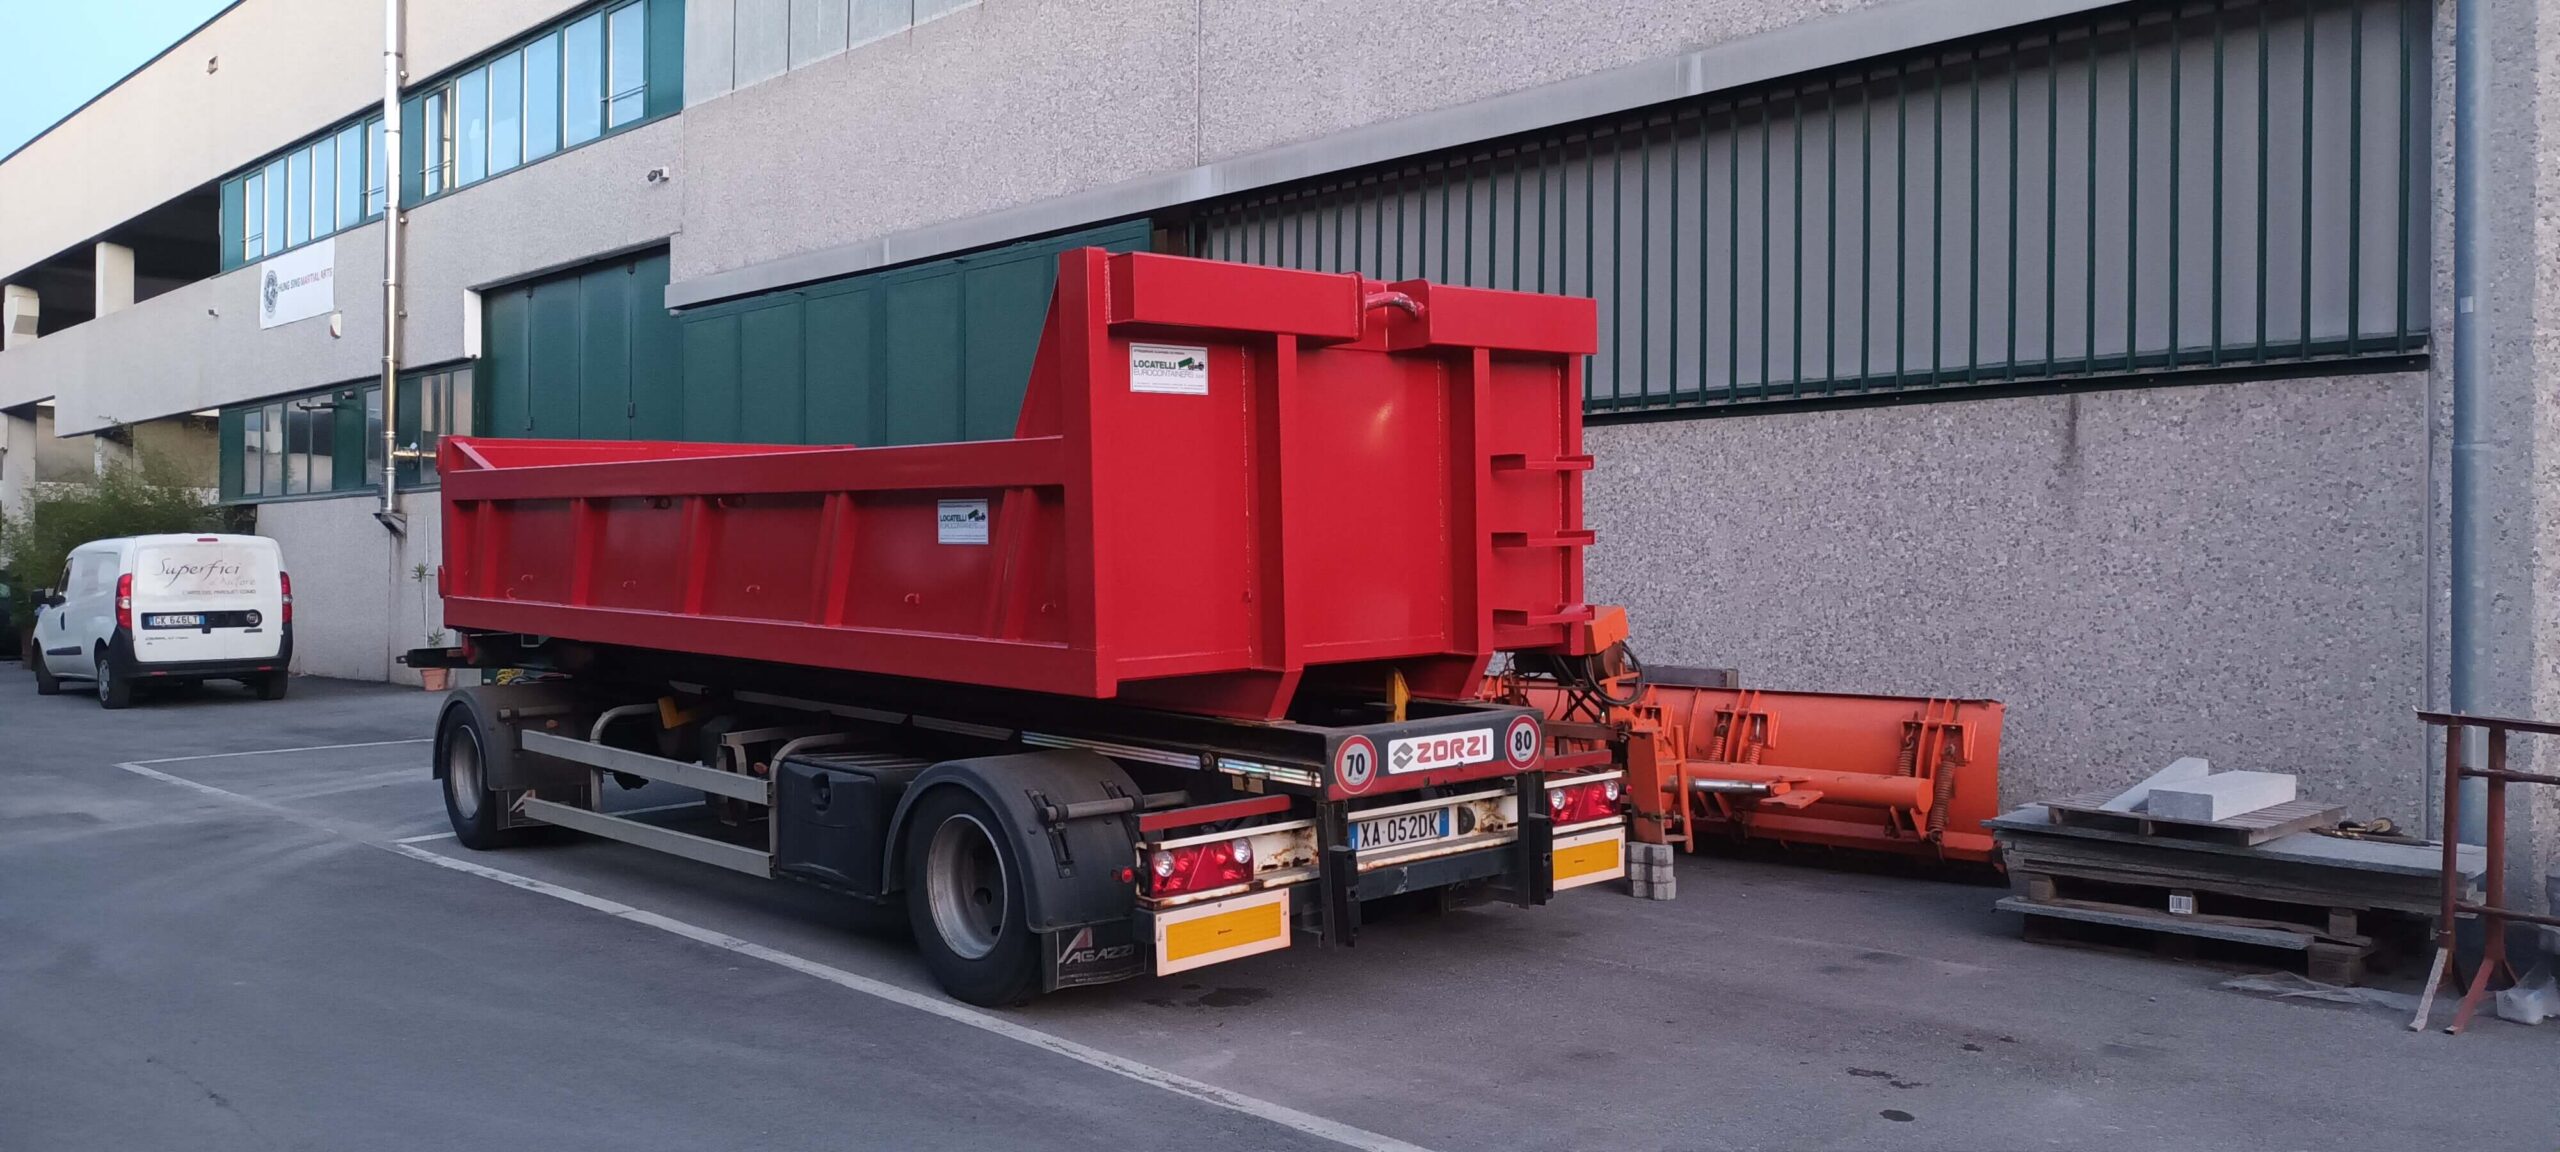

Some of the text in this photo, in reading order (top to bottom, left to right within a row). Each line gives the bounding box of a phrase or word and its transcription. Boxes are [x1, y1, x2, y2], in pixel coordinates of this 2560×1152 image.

[321, 267, 333, 279] ARTS
[1133, 360, 1176, 370] LOCATELLI
[940, 514, 967, 522] LOCATELLI
[152, 558, 241, 588] Superfici
[1416, 735, 1488, 764] ZORZI
[1514, 730, 1532, 752] 80
[1346, 753, 1365, 777] 70
[1361, 819, 1381, 848] XA
[1387, 810, 1438, 843] 052DK
[1066, 943, 1135, 965] AGAZZI
